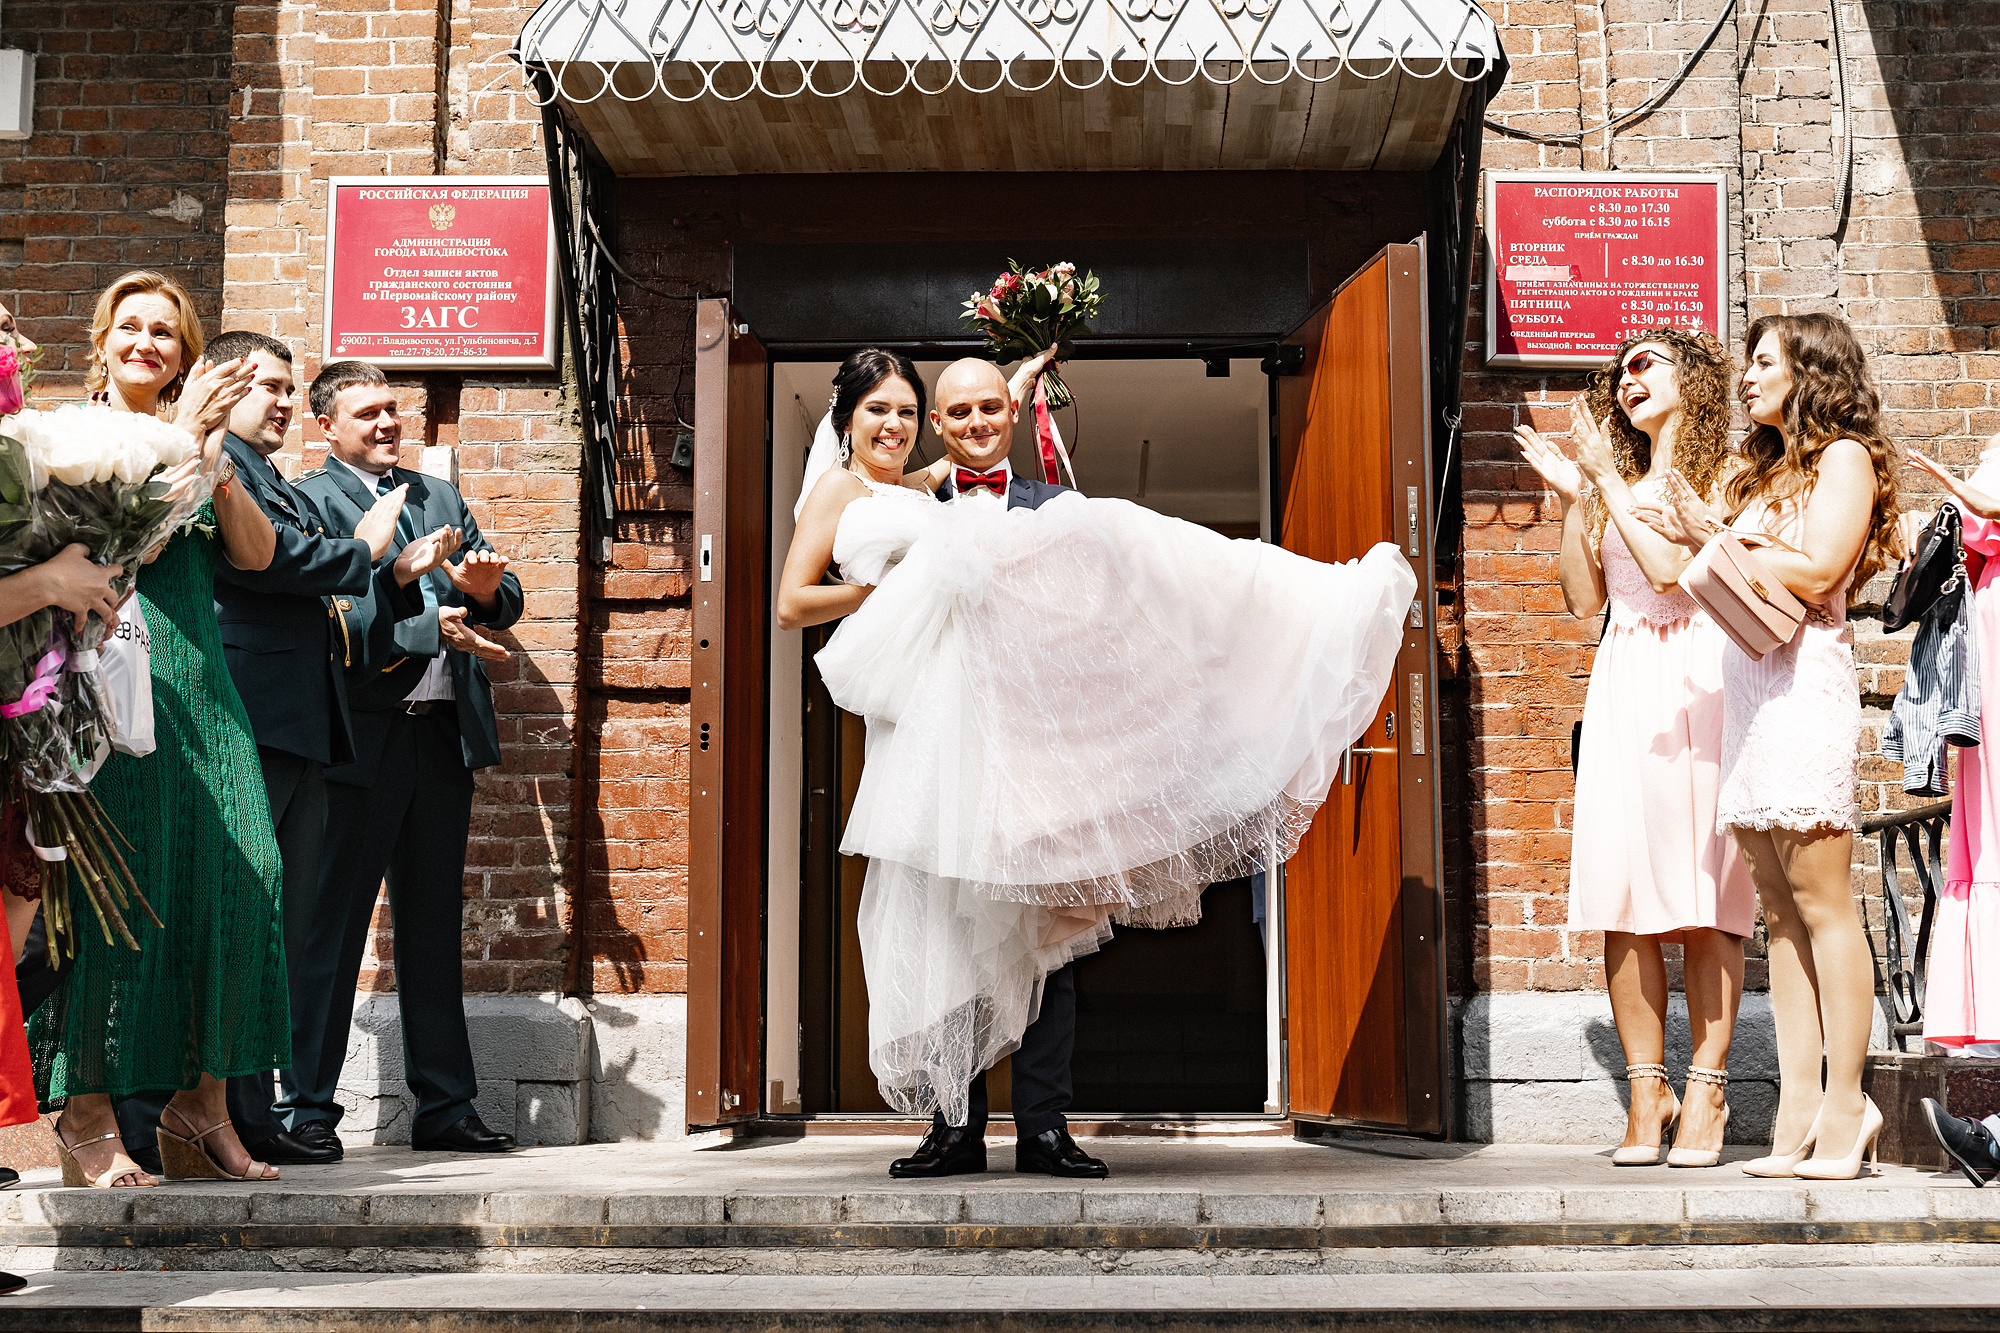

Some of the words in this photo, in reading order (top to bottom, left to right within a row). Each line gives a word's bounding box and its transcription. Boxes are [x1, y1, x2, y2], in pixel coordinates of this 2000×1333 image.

[359, 187, 449, 200] РОССИЙСКАЯ
[451, 189, 529, 200] ФЕДЕРАЦИЯ
[1534, 188, 1621, 199] РАСПОРЯДОК
[1625, 188, 1679, 198] РАБОТЫ
[1589, 204, 1596, 213] с
[1597, 203, 1622, 213] 8.30
[1623, 206, 1638, 214] до
[1641, 203, 1670, 213] 17.30
[1543, 216, 1586, 228] суббота
[1589, 218, 1596, 227] с
[1598, 217, 1622, 227] 8.30
[1623, 219, 1638, 228] до
[1641, 217, 1670, 227] 16.15
[1574, 232, 1602, 240] ПРИЁМ
[392, 238, 491, 248] АДМИНИСТРАЦИЯ
[1509, 243, 1566, 253] ВТОРНИК
[375, 247, 417, 258] ГОРОДА
[420, 248, 508, 258] ВЛАДИВОСТОКА
[1510, 255, 1547, 265] СРЕДА
[1621, 257, 1629, 266] с
[1630, 256, 1655, 266] 8.30
[1656, 258, 1672, 267] до
[1675, 256, 1704, 266] 16.30
[384, 267, 419, 278] Отдел
[421, 270, 463, 278] записи
[464, 270, 499, 278] актов
[368, 281, 451, 291] гражданского
[452, 282, 513, 290] состояния
[1624, 282, 1699, 290] ТОРЖЕСТВЕННУЮ
[363, 290, 378, 300] по
[380, 289, 473, 303] Первомайскому
[476, 291, 517, 303] району
[1516, 289, 1579, 297] РЕГИСТРАЦИЮ
[1608, 289, 1616, 297] О
[1616, 290, 1664, 298] РОЖДЕНИИ
[1510, 300, 1571, 310] ПЯТНИЦА
[1620, 302, 1628, 311] с
[1630, 300, 1653, 310] 8.30
[1655, 303, 1671, 312] до
[1674, 301, 1703, 311] 16.30
[400, 306, 478, 328] ЗАГС
[1509, 314, 1565, 324] СУББОТА
[1621, 315, 1628, 324] с
[1631, 314, 1654, 324] 8.30
[1656, 317, 1671, 326] до
[1614, 331, 1622, 340] с
[340, 336, 375, 346] 690021,
[377, 336, 442, 346] г.Владивосток,
[444, 336, 522, 346] ул.Гульбиновича,
[524, 336, 537, 346] д.3
[1526, 342, 1573, 350] ВЫХОДНОЙ:
[388, 348, 448, 358] тел.27-78-20,
[448, 348, 489, 358] 27-86-32
